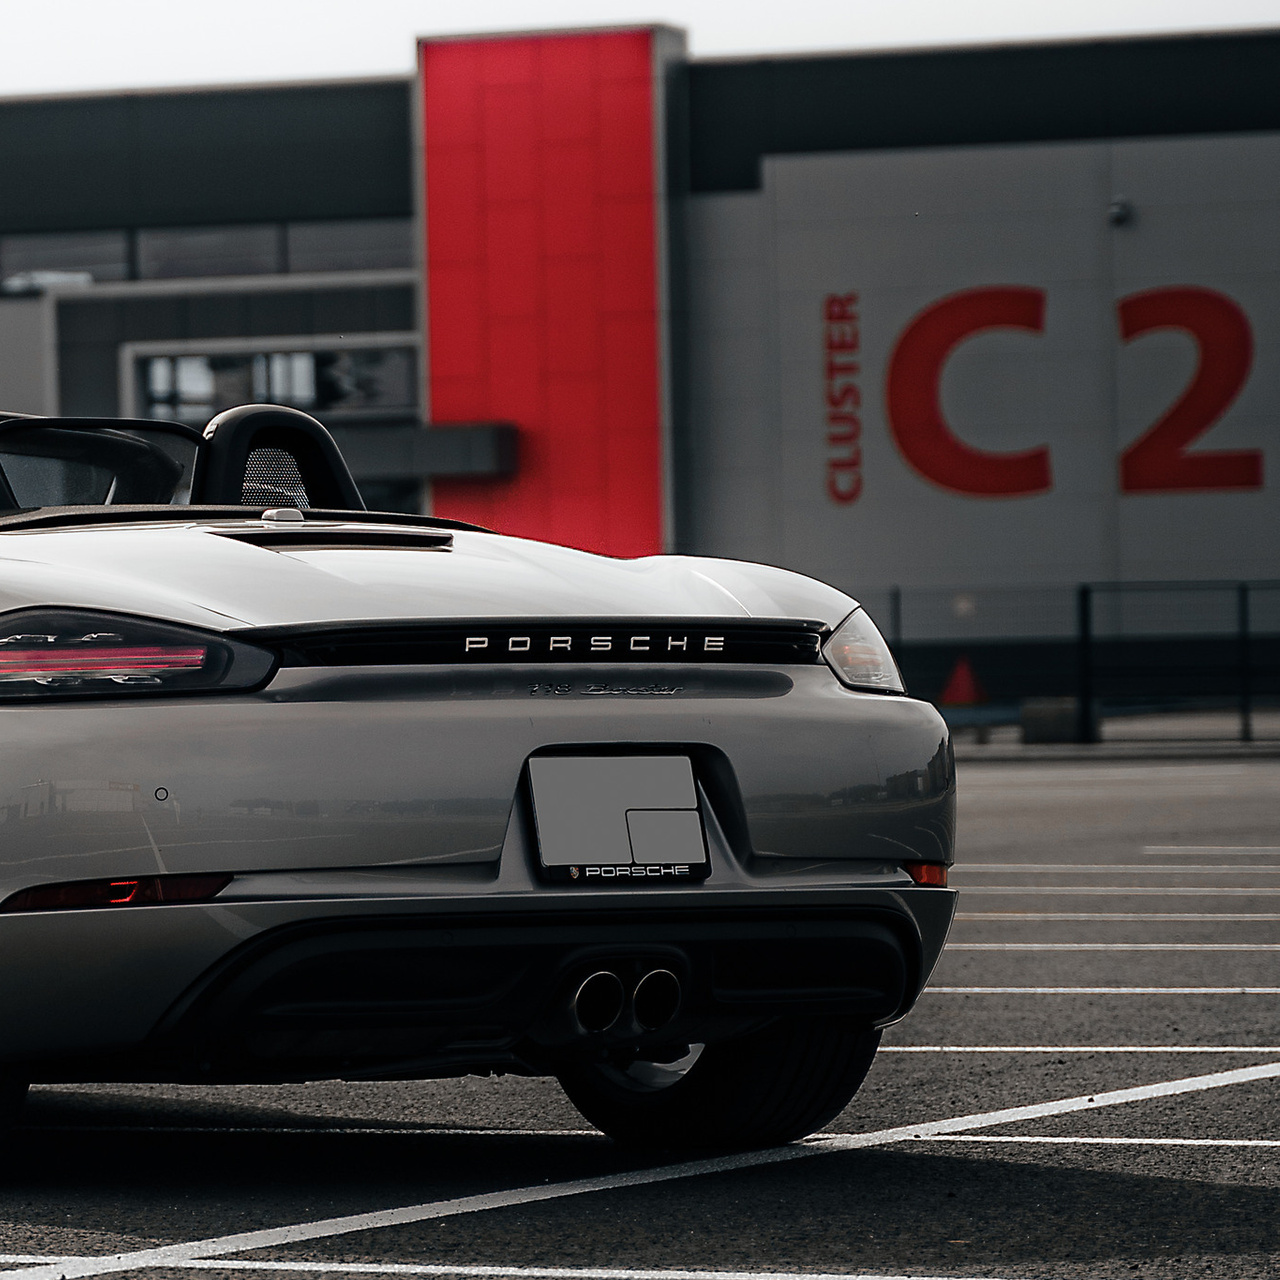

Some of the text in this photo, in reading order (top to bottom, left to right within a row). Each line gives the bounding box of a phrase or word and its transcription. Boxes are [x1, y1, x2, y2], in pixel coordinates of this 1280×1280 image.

[824, 291, 862, 505] CLUSTER
[887, 286, 1263, 497] C 2
[465, 636, 725, 652] PORSCHE
[527, 683, 571, 696] 718
[585, 865, 689, 876] PORSCHE
